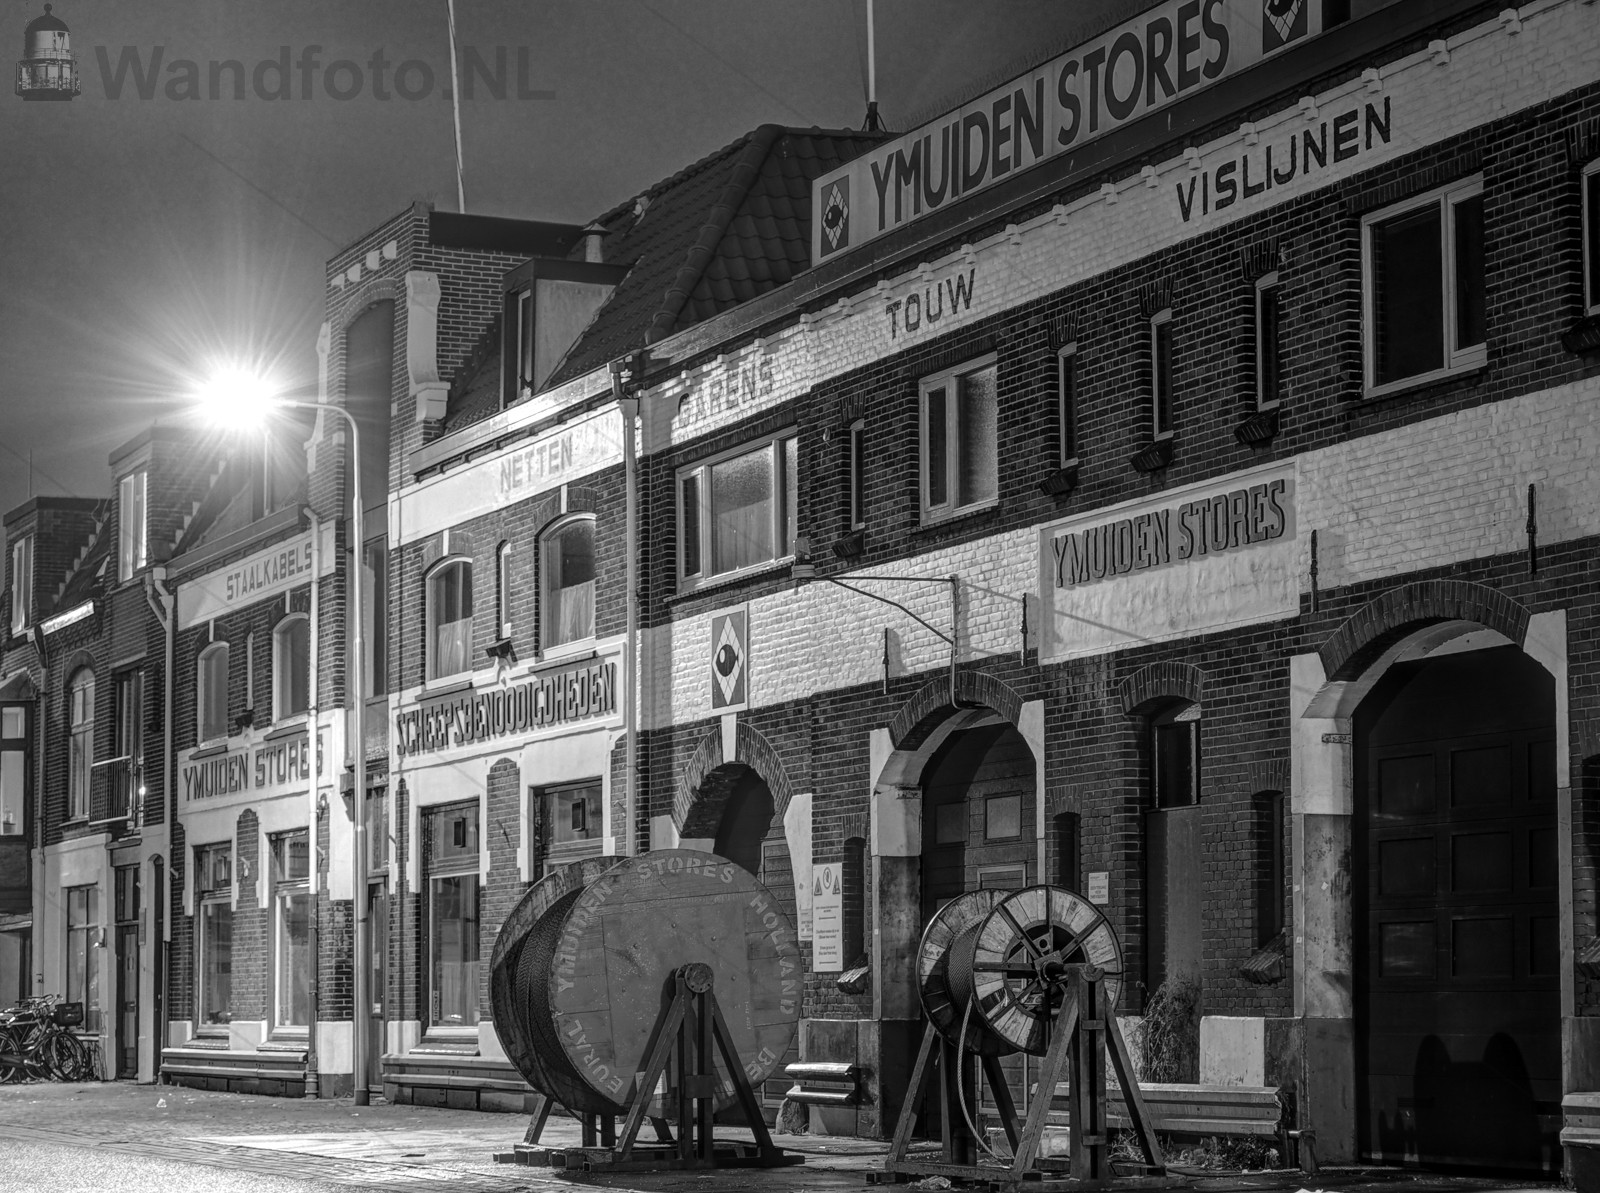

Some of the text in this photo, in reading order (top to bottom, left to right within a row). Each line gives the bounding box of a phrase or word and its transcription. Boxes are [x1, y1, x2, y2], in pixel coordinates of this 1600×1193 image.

[870, 0, 1230, 232] YMUIDEN STORES
[1176, 95, 1392, 223] VISLIJNEN
[885, 268, 976, 340] TOUW
[500, 431, 573, 494] NETTEN
[1050, 478, 1286, 588] YMUIDEN STORES
[226, 541, 312, 601] STAALKABELS
[183, 752, 249, 801] YMUIDEN
[636, 856, 735, 885] STORES
